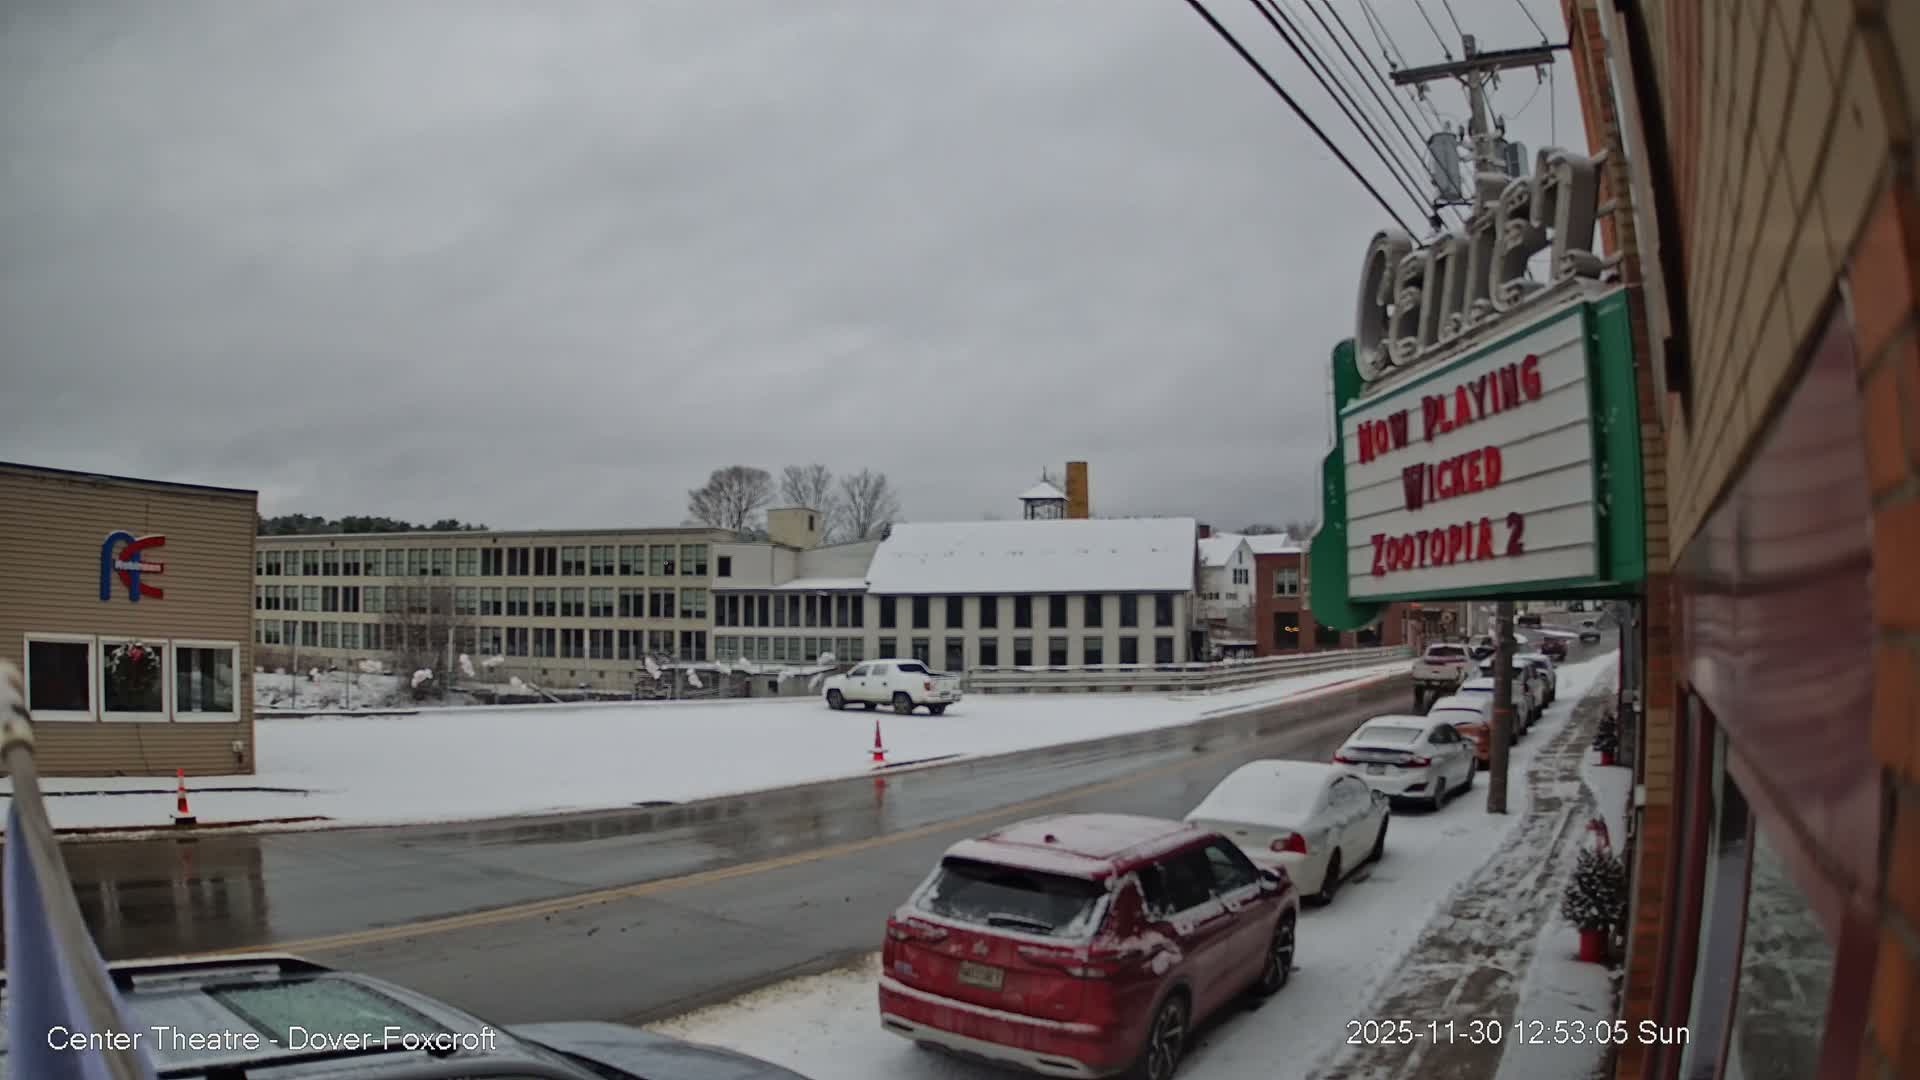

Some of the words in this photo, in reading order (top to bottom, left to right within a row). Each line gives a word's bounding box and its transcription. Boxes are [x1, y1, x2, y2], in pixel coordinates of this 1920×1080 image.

[1357, 409, 1408, 464] NOW
[1421, 354, 1541, 442] PLAYING
[1402, 446, 1502, 512] WICKED
[1371, 517, 1493, 576] ZOOTOPIA
[1506, 512, 1525, 556] 2
